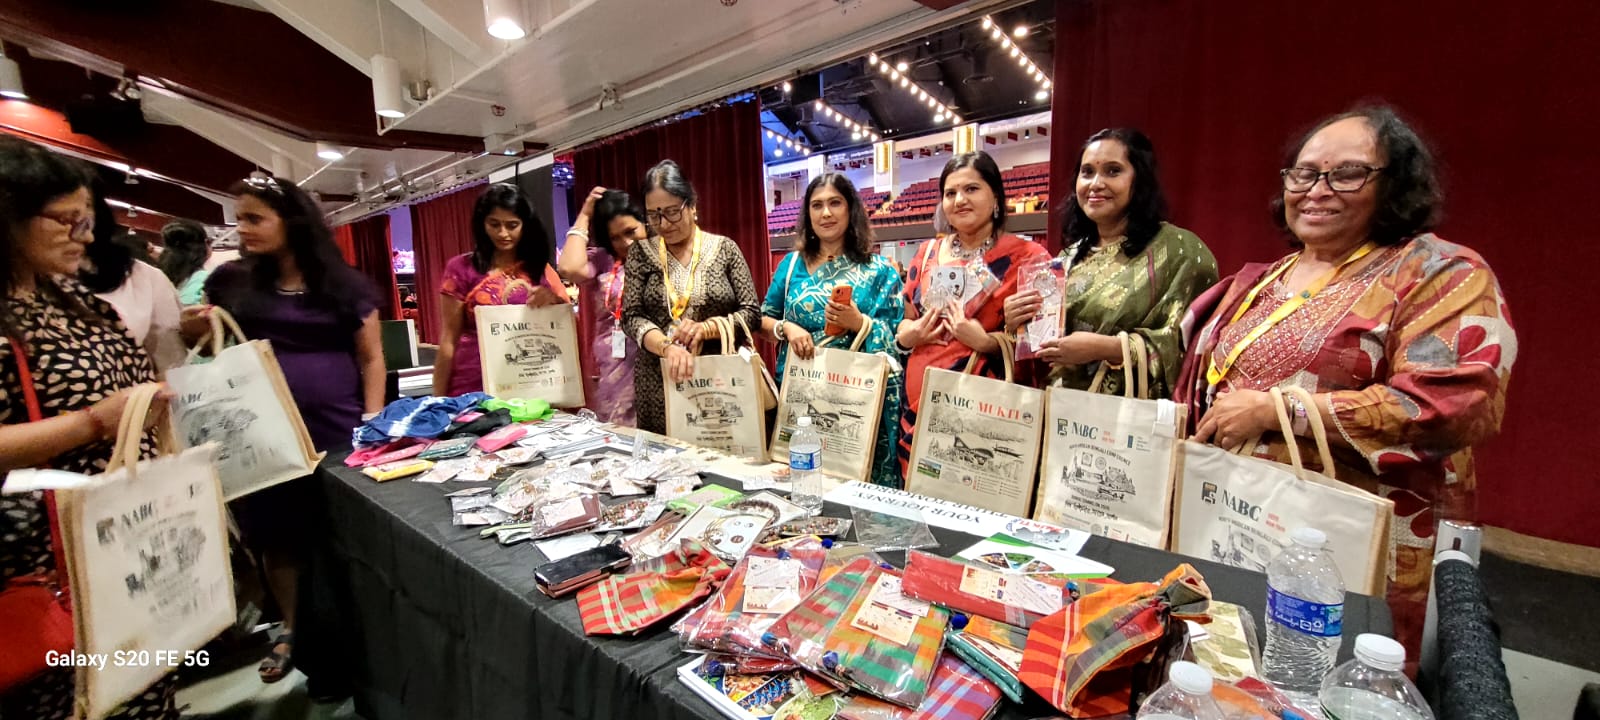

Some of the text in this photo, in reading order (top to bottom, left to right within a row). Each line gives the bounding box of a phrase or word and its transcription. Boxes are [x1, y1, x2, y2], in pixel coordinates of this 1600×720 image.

[503, 322, 532, 332] NABC
[798, 367, 863, 387] NABC MUKTI
[942, 392, 975, 410] NABC
[978, 401, 1021, 421] MUKTI
[1071, 421, 1099, 440] NABC
[1221, 488, 1263, 523] NABC
[930, 508, 980, 524] YOUR
